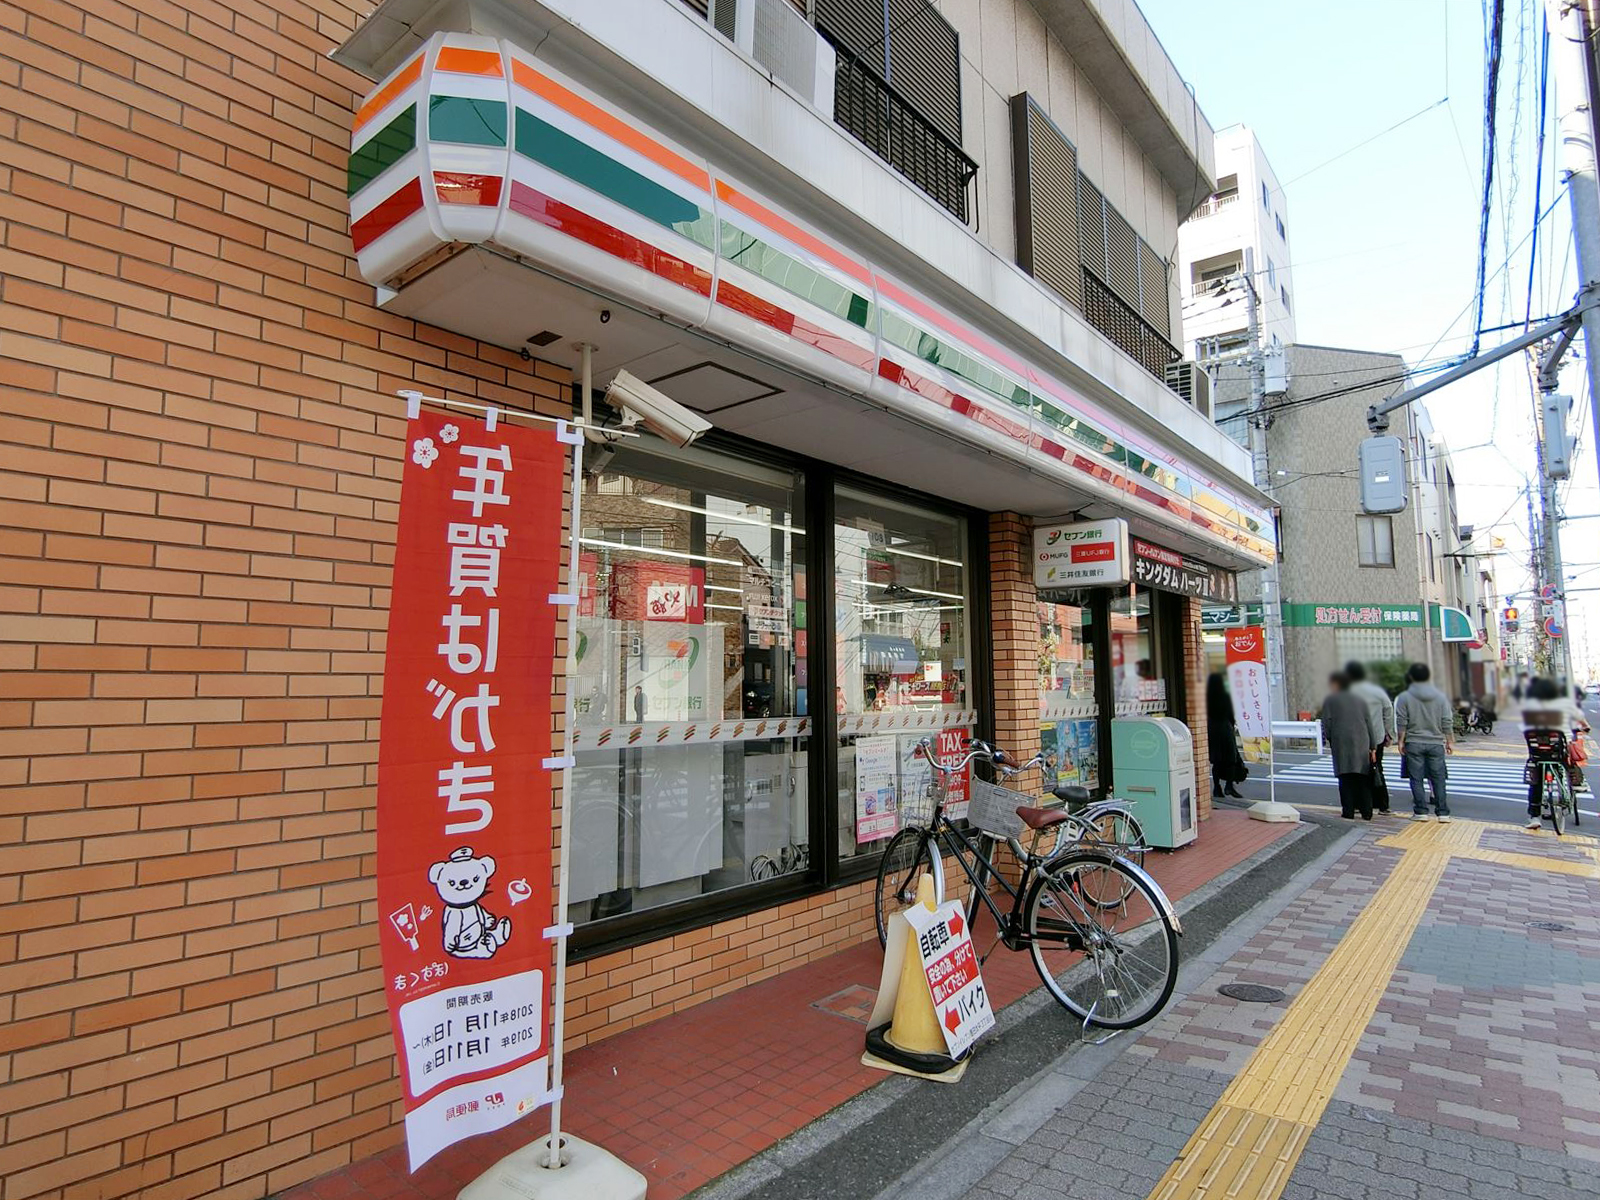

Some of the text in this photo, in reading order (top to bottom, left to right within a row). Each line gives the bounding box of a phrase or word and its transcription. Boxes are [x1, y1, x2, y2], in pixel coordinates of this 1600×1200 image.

[1063, 529, 1103, 541] セブン銀行
[1050, 552, 1069, 560] MUFG
[1059, 568, 1105, 580] 三井住友銀行
[1315, 606, 1382, 625] 処方せん受付
[940, 731, 962, 753] TAX
[920, 920, 950, 960] 自転車
[958, 985, 985, 1023] バイク
